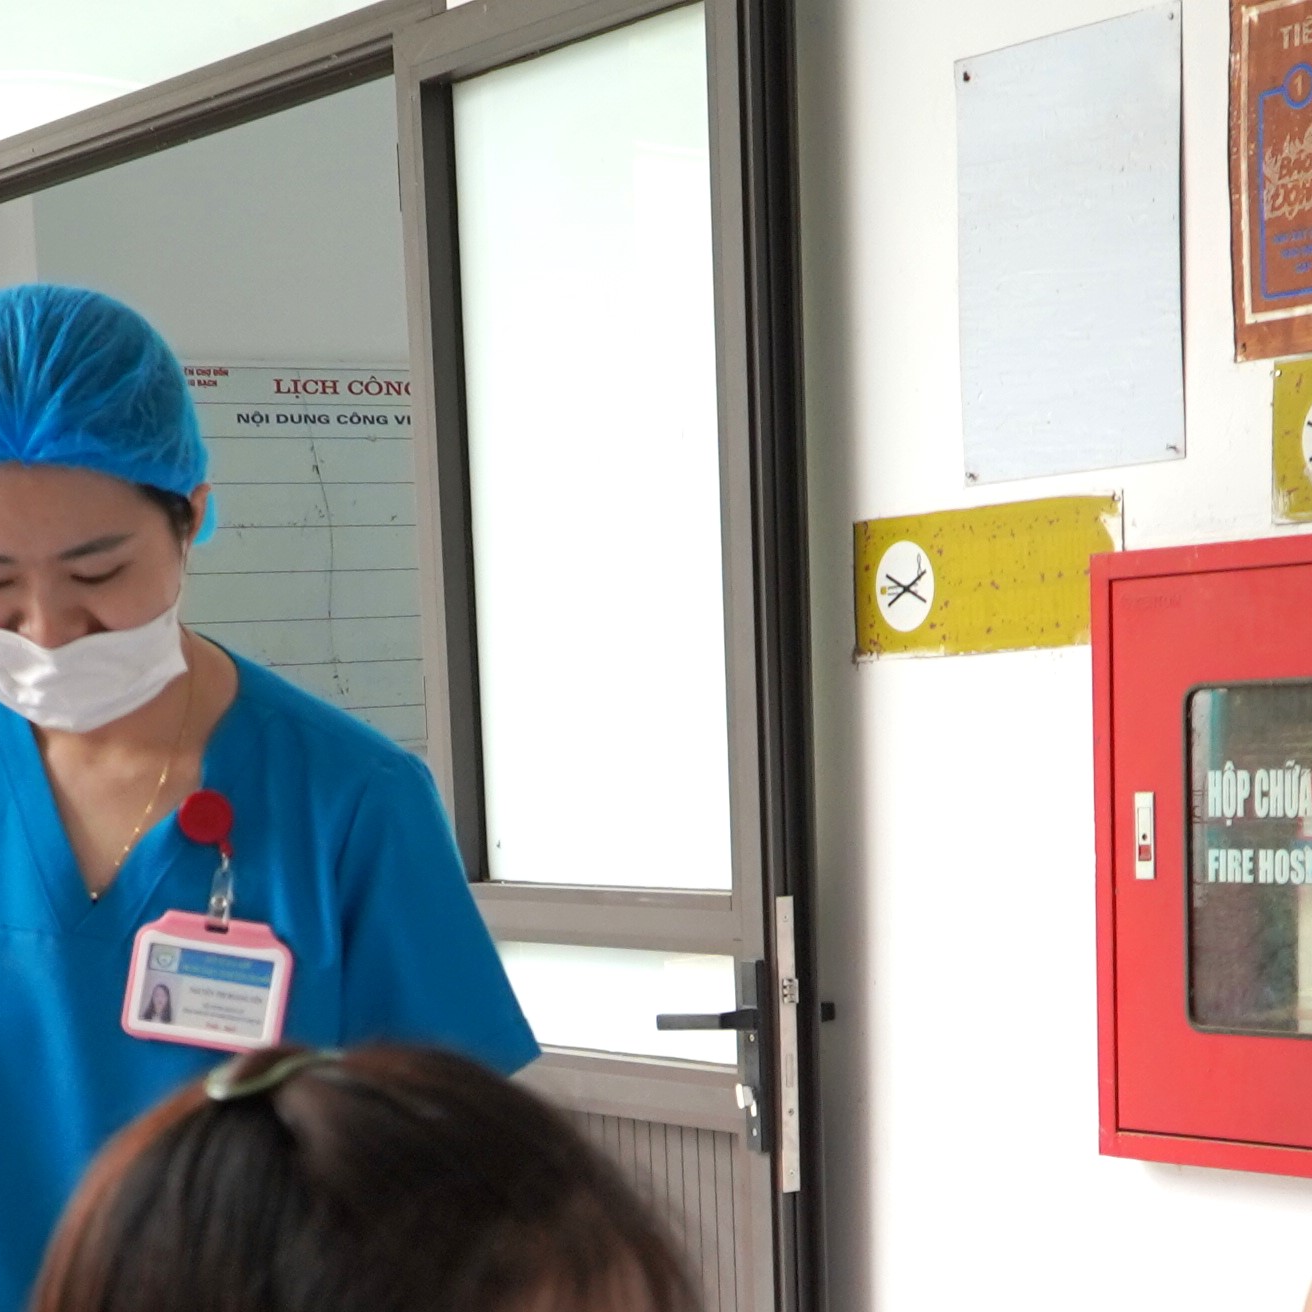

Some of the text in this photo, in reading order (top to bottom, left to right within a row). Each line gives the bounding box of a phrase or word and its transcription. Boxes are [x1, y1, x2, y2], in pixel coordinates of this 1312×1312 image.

[1293, 75, 1303, 96] 1
[273, 378, 340, 399] LỊCH
[237, 411, 411, 427] NỘI DUNG CÔNG VI
[1207, 760, 1251, 826] HỘP
[1208, 848, 1255, 883] FIRE
